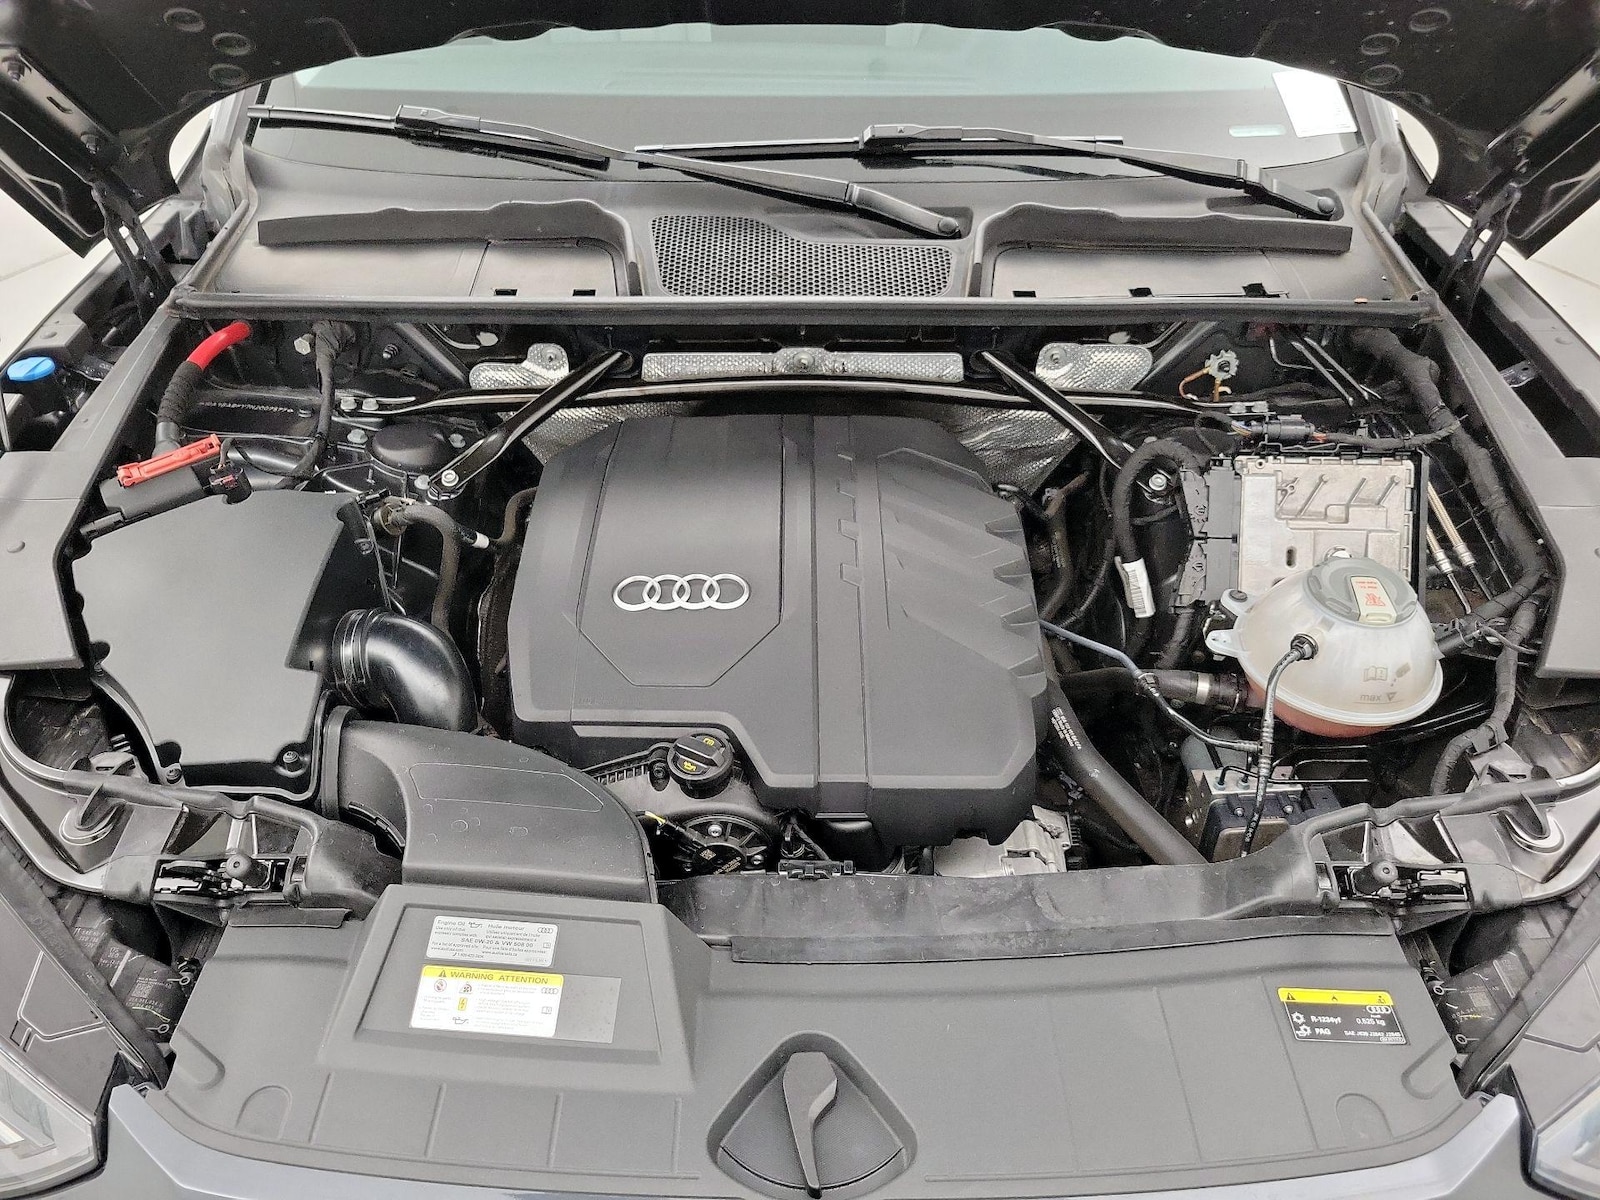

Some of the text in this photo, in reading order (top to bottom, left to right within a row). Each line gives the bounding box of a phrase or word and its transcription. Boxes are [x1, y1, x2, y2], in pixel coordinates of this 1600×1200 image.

[450, 970, 548, 984] WARNING ATTENTION
[1310, 1016, 1342, 1024] R-1234yf
